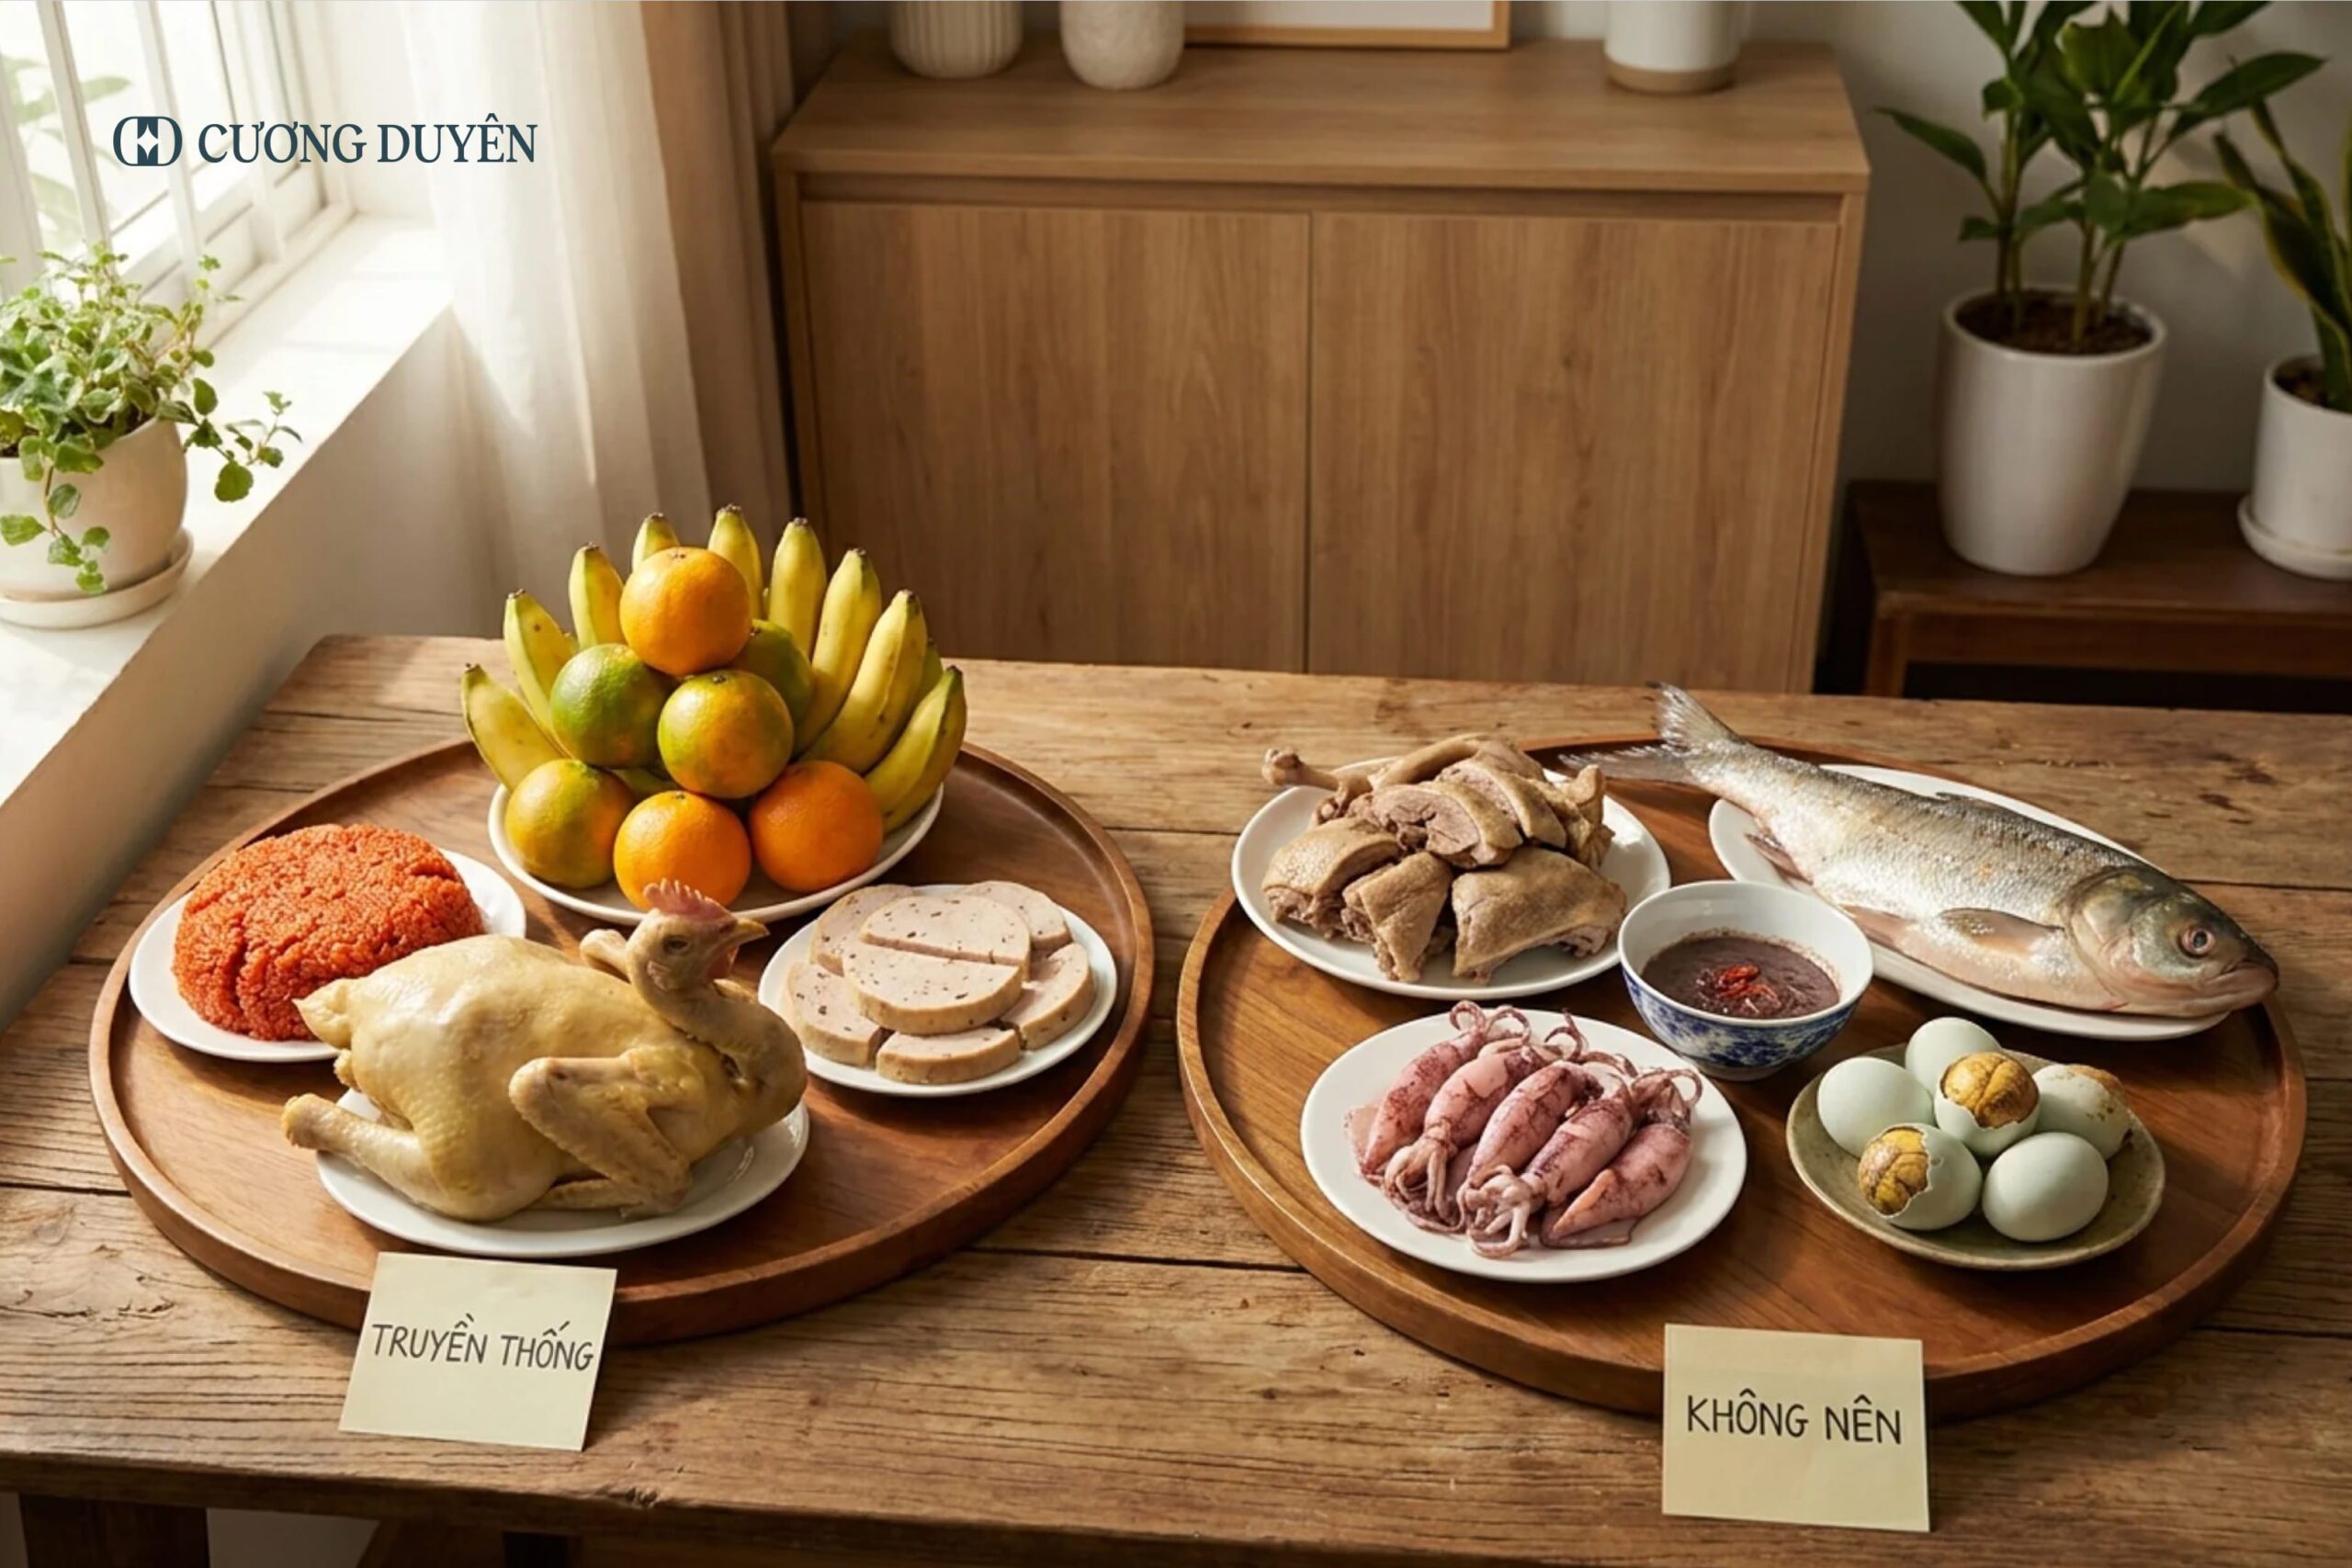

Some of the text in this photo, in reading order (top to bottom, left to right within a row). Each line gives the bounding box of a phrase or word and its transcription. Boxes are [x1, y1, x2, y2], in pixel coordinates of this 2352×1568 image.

[371, 1313, 594, 1371] TRUYỀN THỐNG
[1688, 1387, 1902, 1445] KHÔNG NÊN
